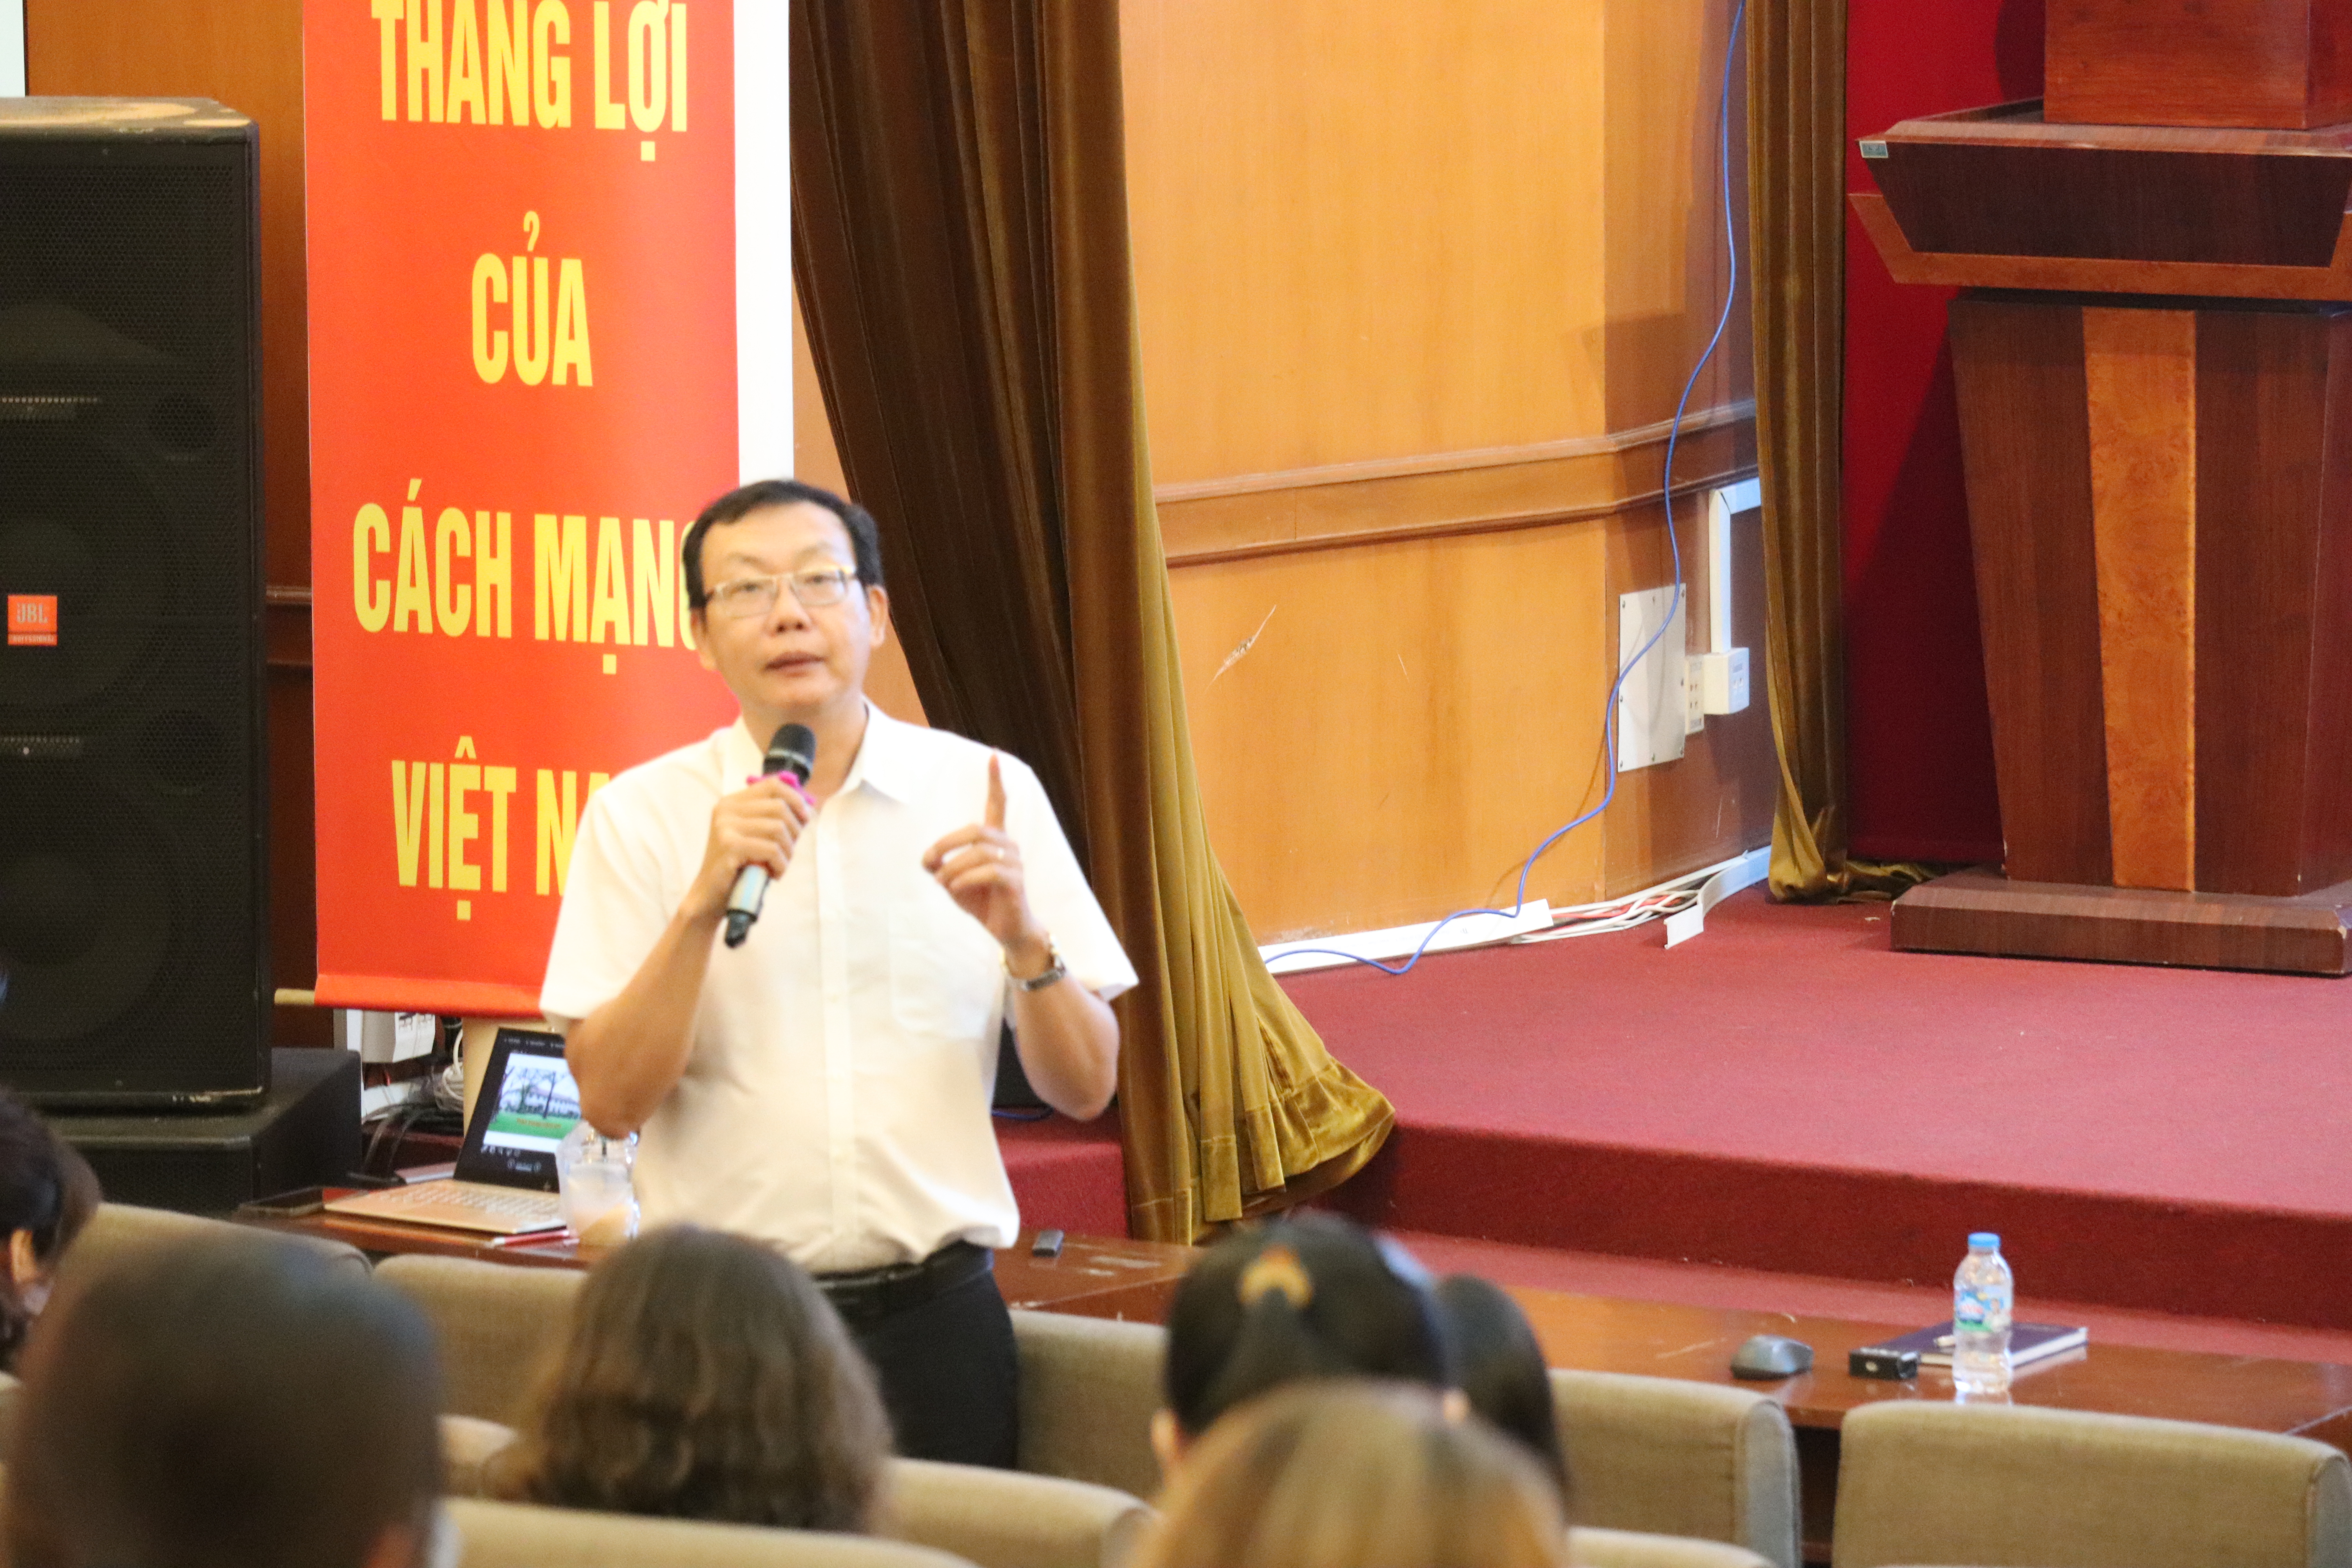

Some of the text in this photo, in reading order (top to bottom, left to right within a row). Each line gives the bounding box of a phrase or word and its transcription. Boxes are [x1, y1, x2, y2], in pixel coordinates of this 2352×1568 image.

[594, 0, 688, 162] LỢI
[471, 211, 593, 387] CỦA
[16, 603, 48, 623] JBL
[353, 478, 512, 638] CÁCH
[392, 735, 517, 920] VIỆT
